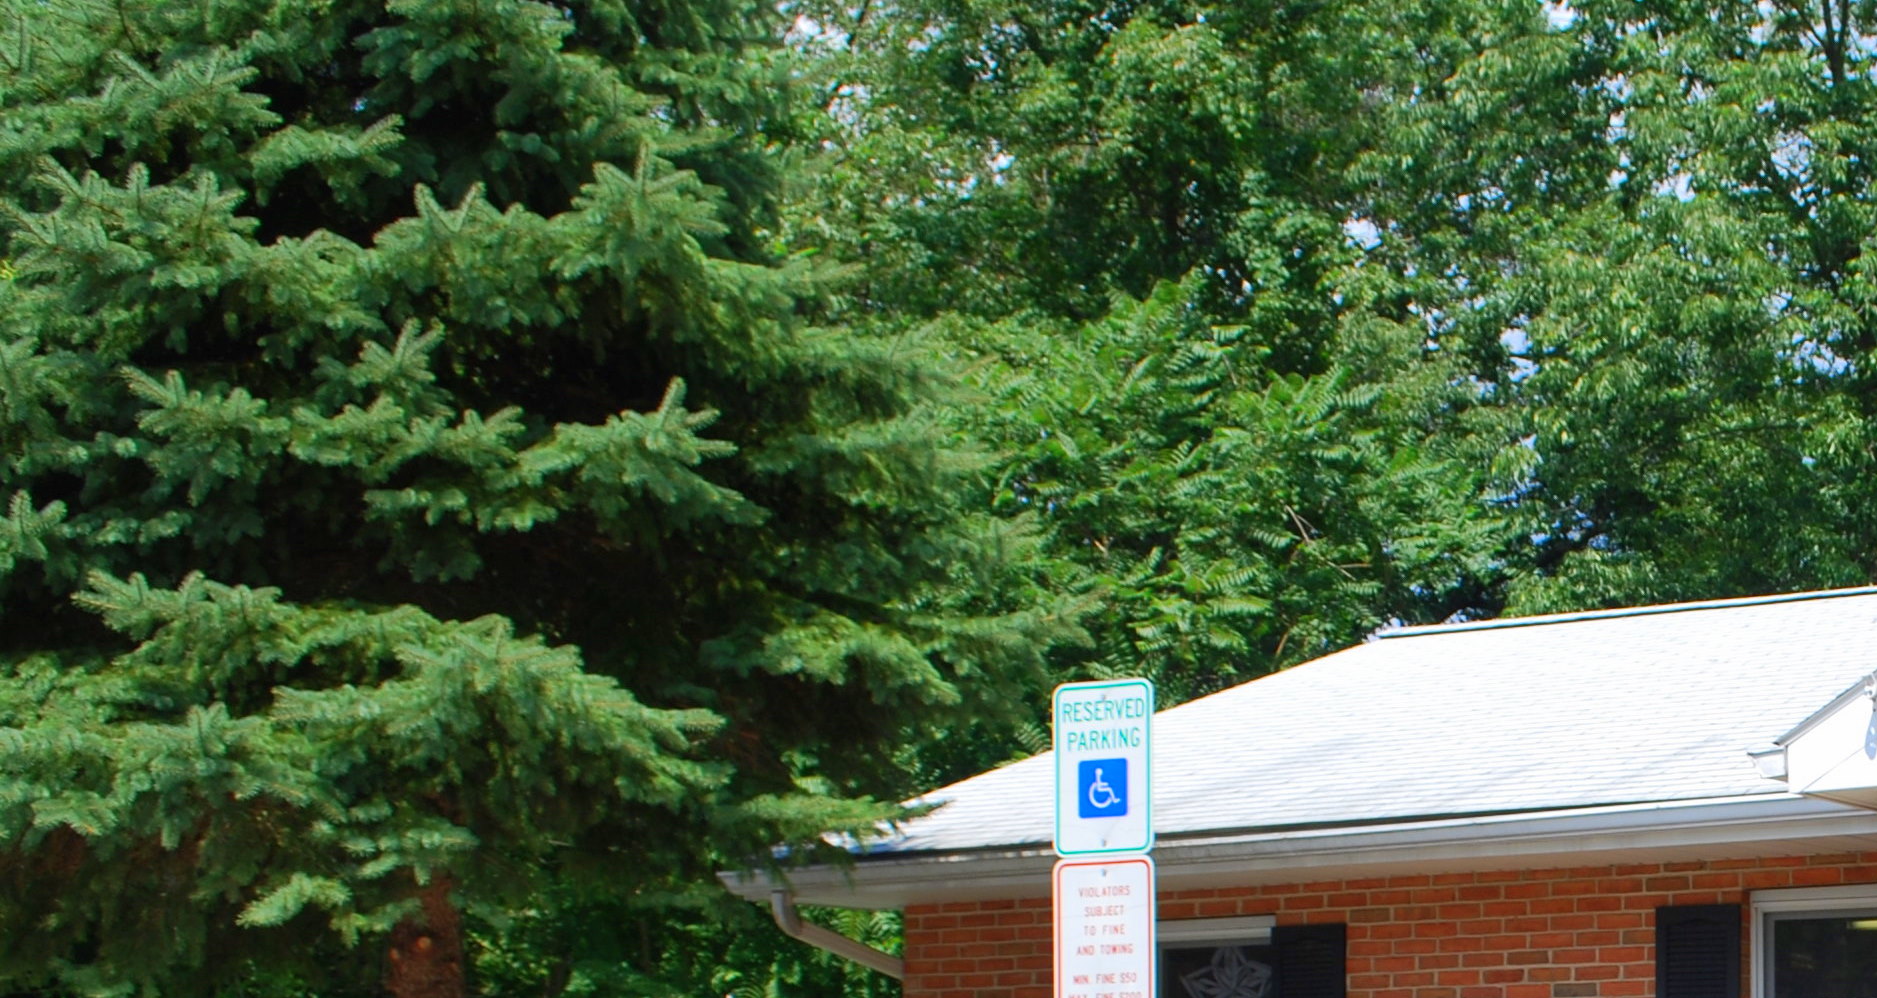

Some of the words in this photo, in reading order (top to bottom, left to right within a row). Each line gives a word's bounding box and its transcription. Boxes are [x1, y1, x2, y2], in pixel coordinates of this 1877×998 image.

[1062, 698, 1145, 723] RESERVED
[1067, 727, 1140, 752] PARKING
[1078, 885, 1131, 898] VIOLATORS
[1084, 905, 1125, 918] SUBJECT
[1084, 925, 1097, 936] TO
[1102, 923, 1125, 936] FINE
[1076, 945, 1095, 956] AND
[1100, 943, 1133, 955] TOWING
[1096, 973, 1116, 984] FINE
[1120, 972, 1137, 984] $50
